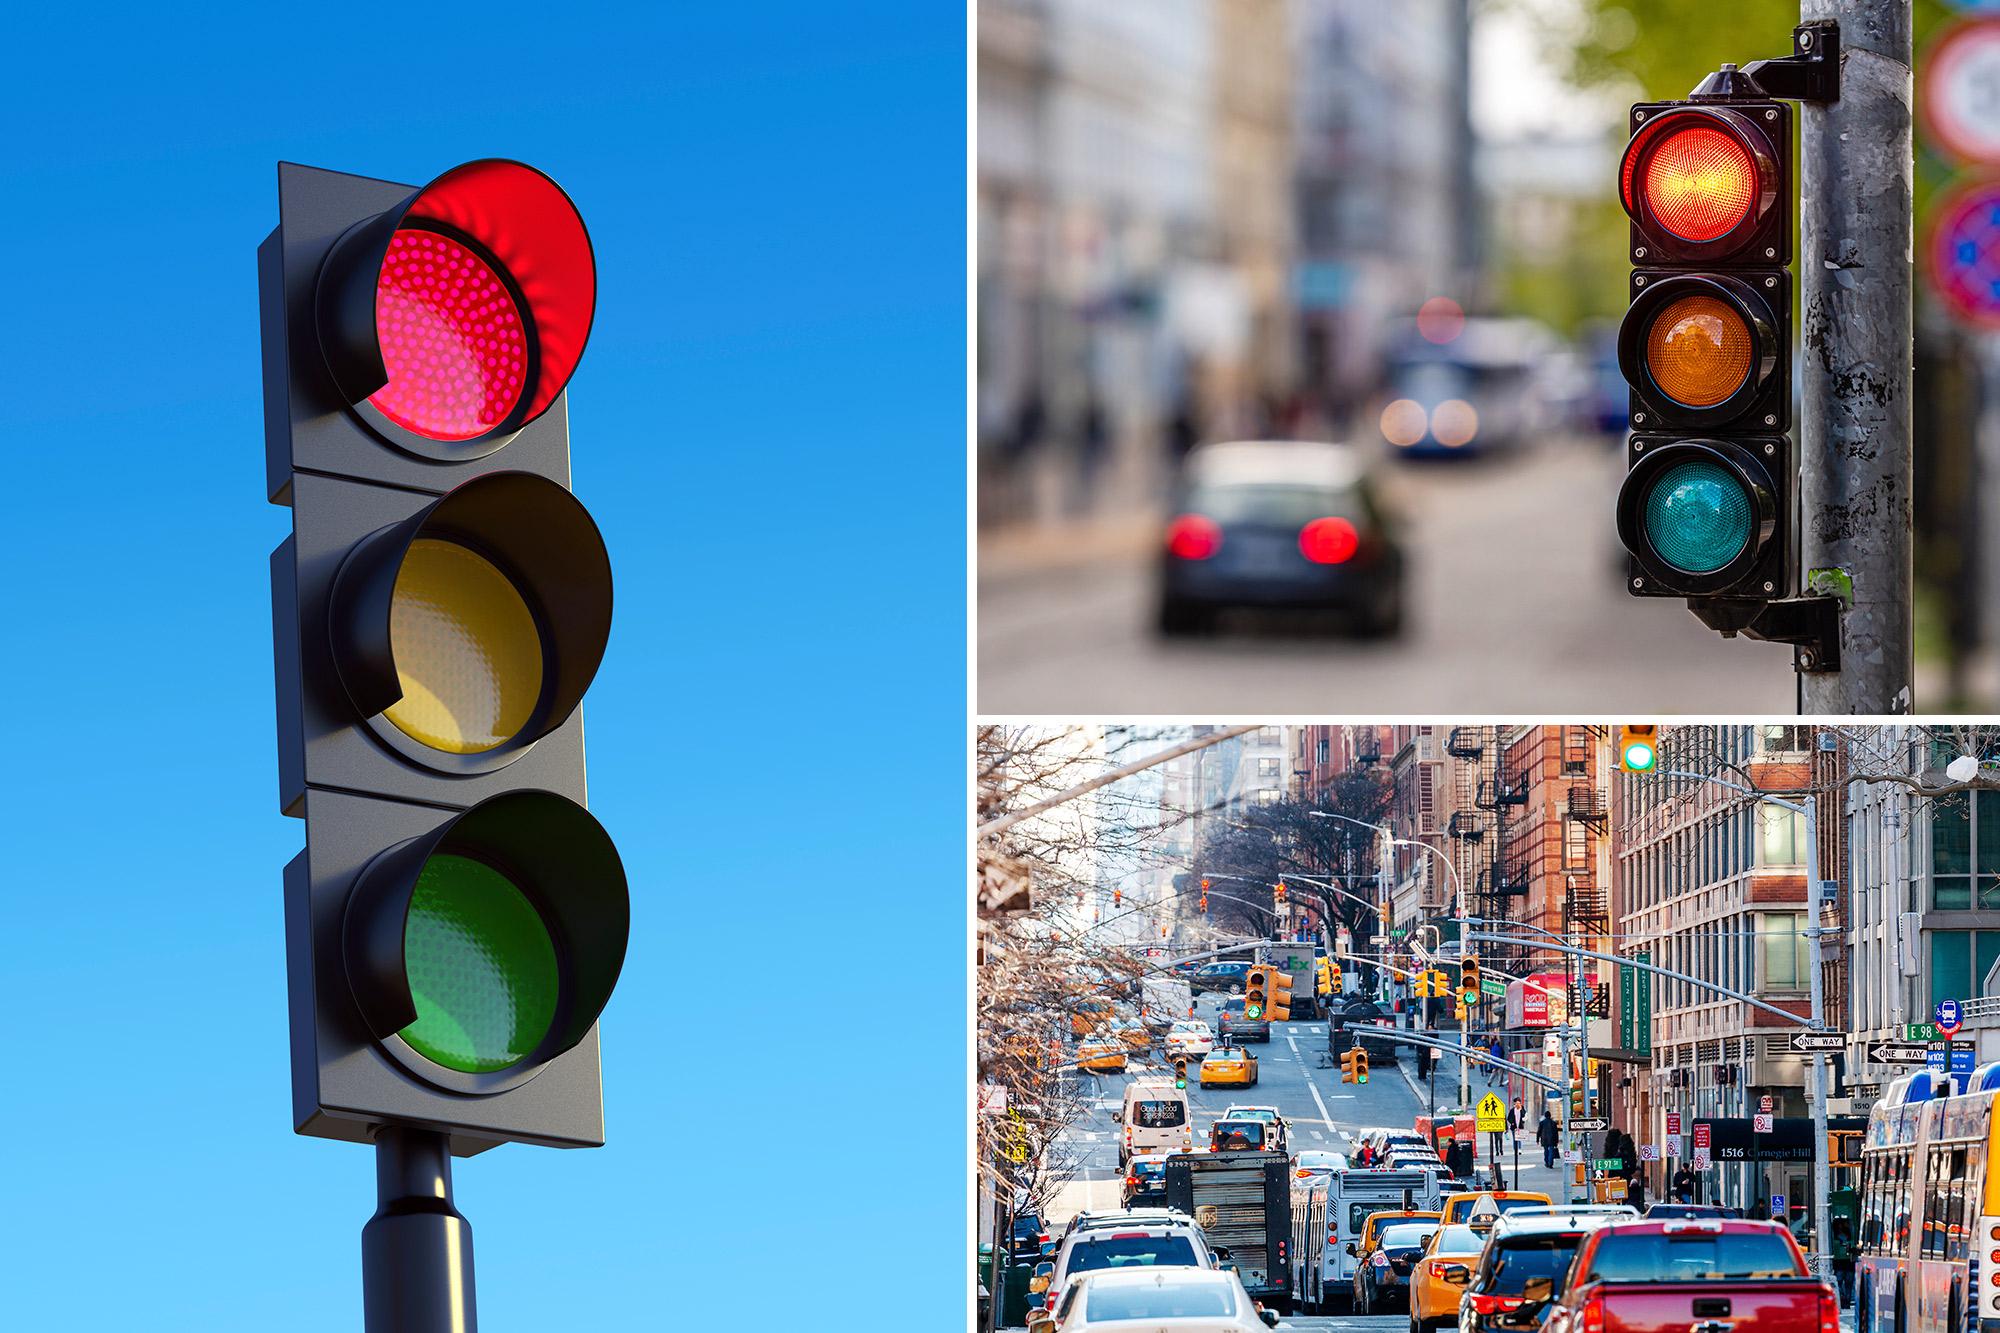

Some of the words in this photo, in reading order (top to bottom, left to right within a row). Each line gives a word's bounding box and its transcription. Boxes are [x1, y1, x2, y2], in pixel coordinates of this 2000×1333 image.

[1268, 956, 1309, 970] edEx
[1911, 1026, 1916, 1038] E
[1920, 1026, 1932, 1038] 98
[1798, 1038, 1815, 1046] ONE
[1822, 1038, 1840, 1046] WAY
[1928, 1042, 1945, 1051] M101
[1879, 1049, 1896, 1058] ONE
[1905, 1050, 1924, 1058] WAY
[1928, 1053, 1944, 1061] M102
[1721, 1148, 1744, 1158] 1516
[1747, 1148, 1791, 1160] Crnegie
[1793, 1147, 1811, 1157] Hill
[1604, 1160, 1611, 1168] 97
[1199, 1212, 1216, 1226] ups
